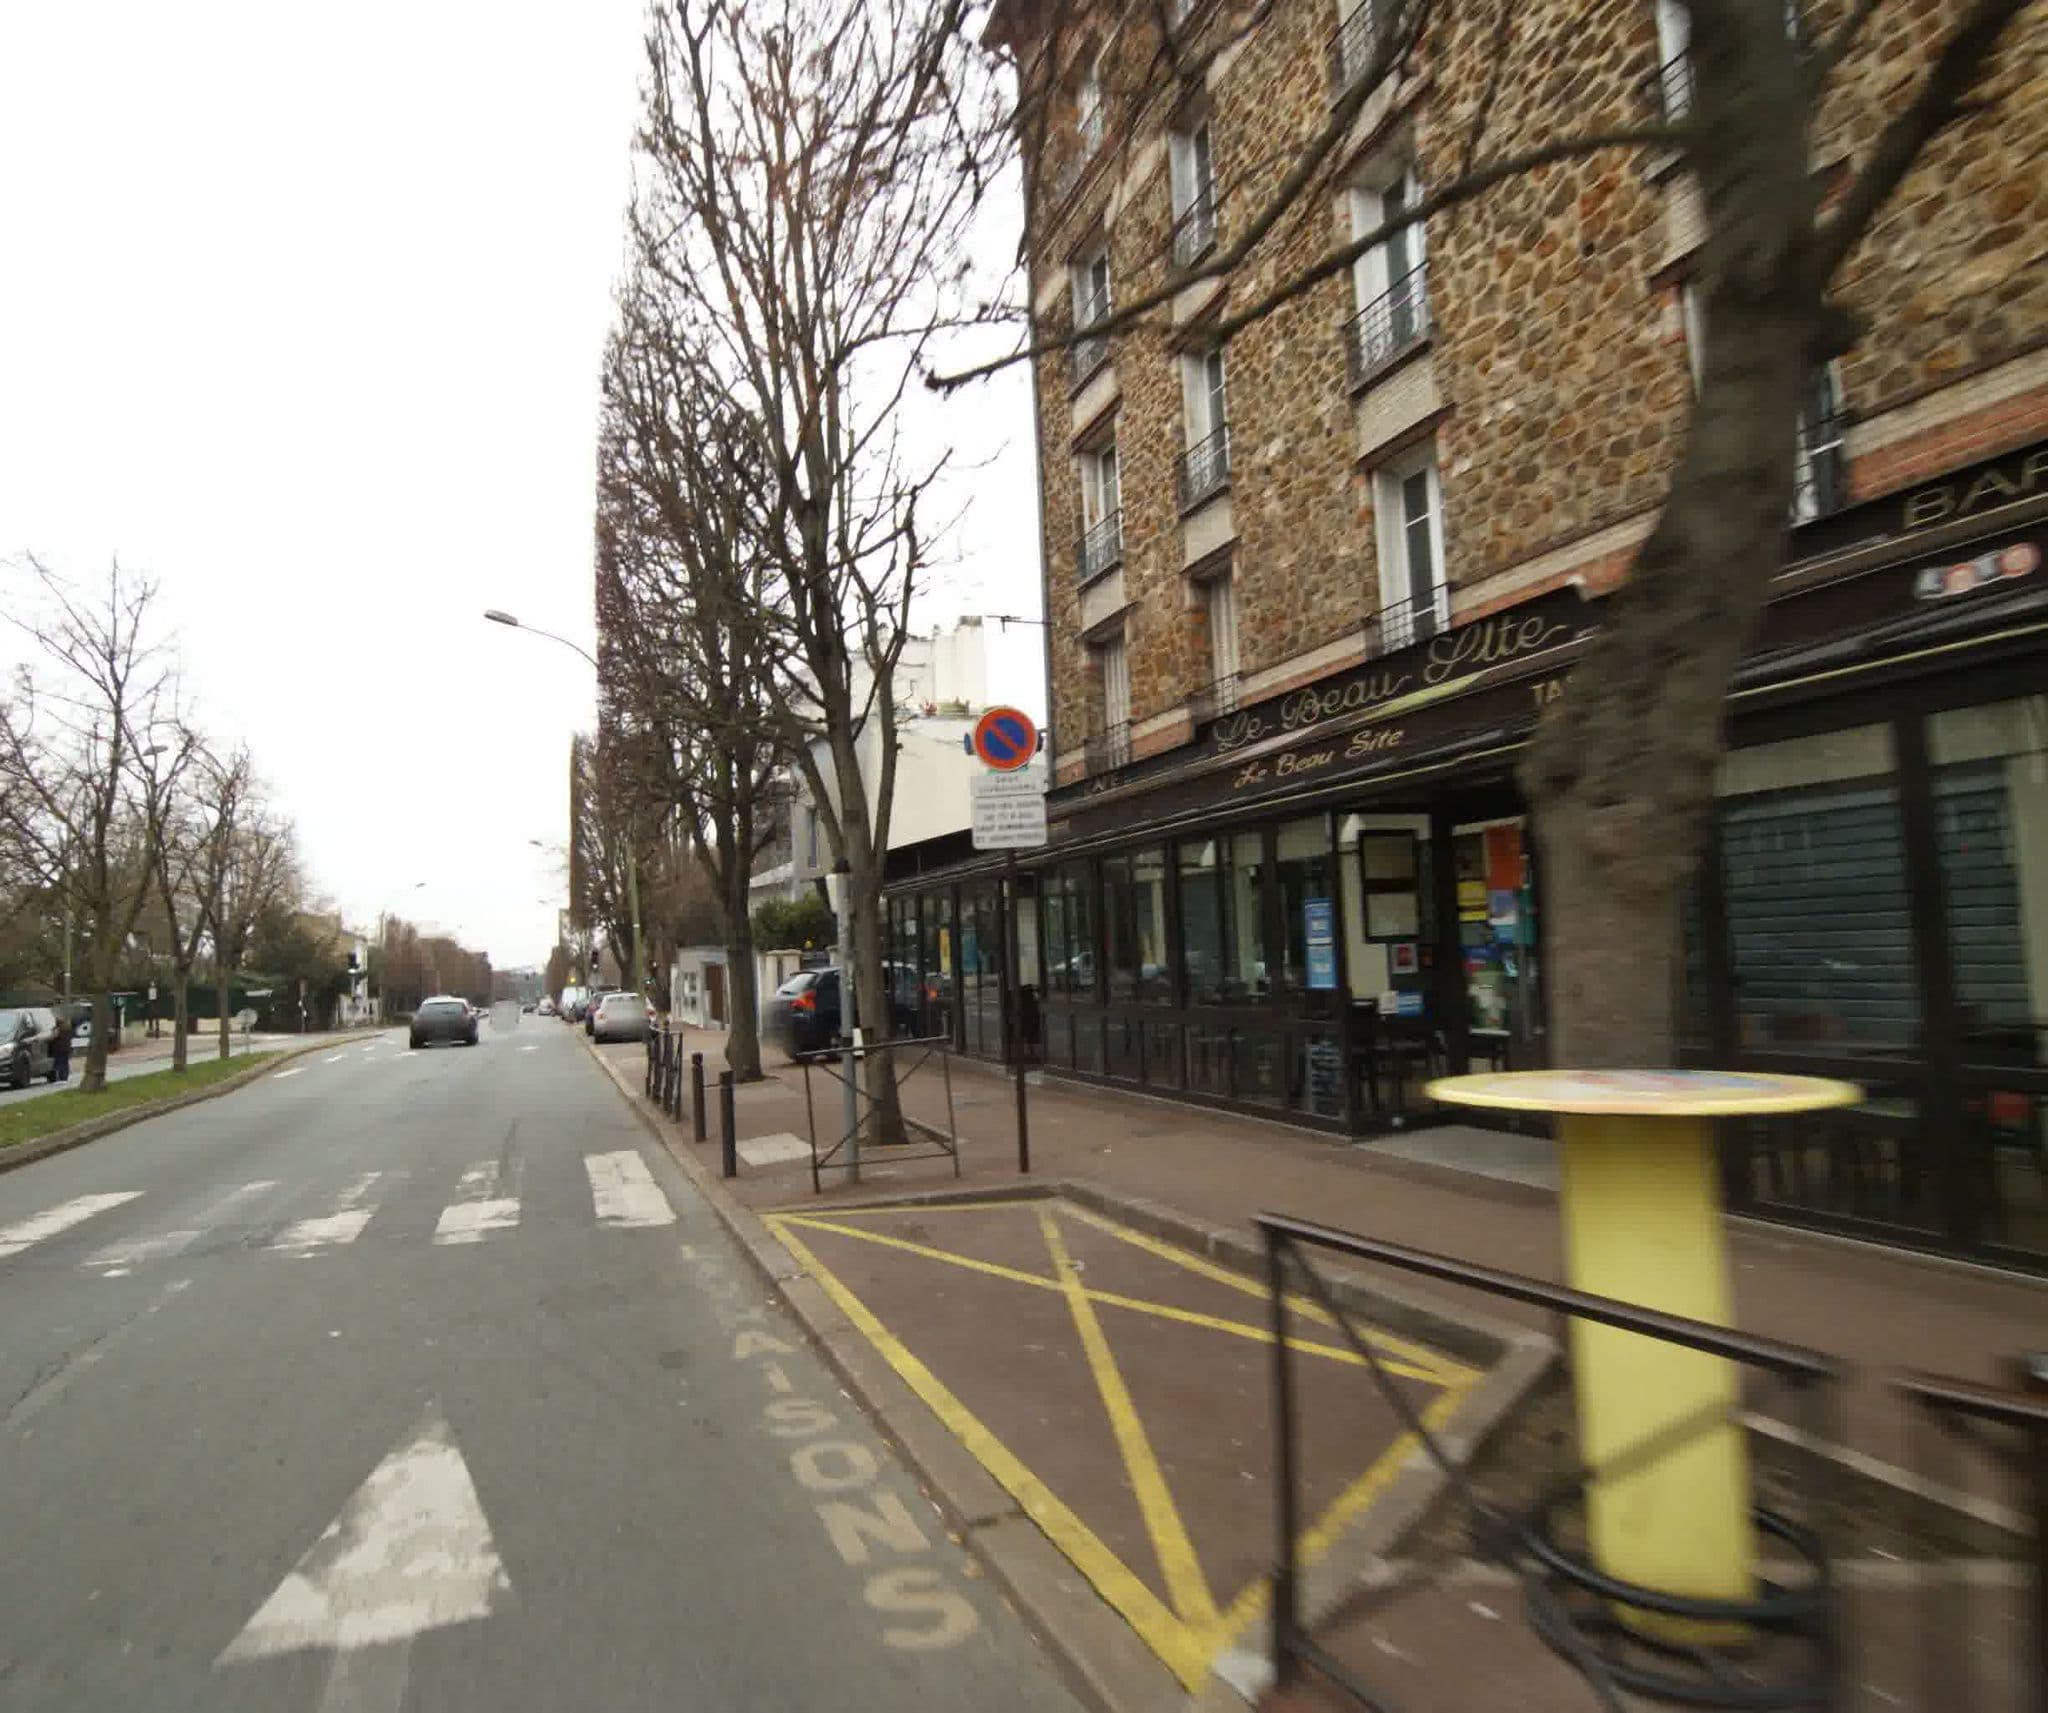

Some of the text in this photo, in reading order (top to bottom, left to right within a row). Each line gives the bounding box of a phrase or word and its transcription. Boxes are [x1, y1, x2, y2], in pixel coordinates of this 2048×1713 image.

[1280, 668, 1412, 729] Beau
[1424, 614, 1569, 684] Site
[1233, 728, 1405, 789] Le Beau Site
